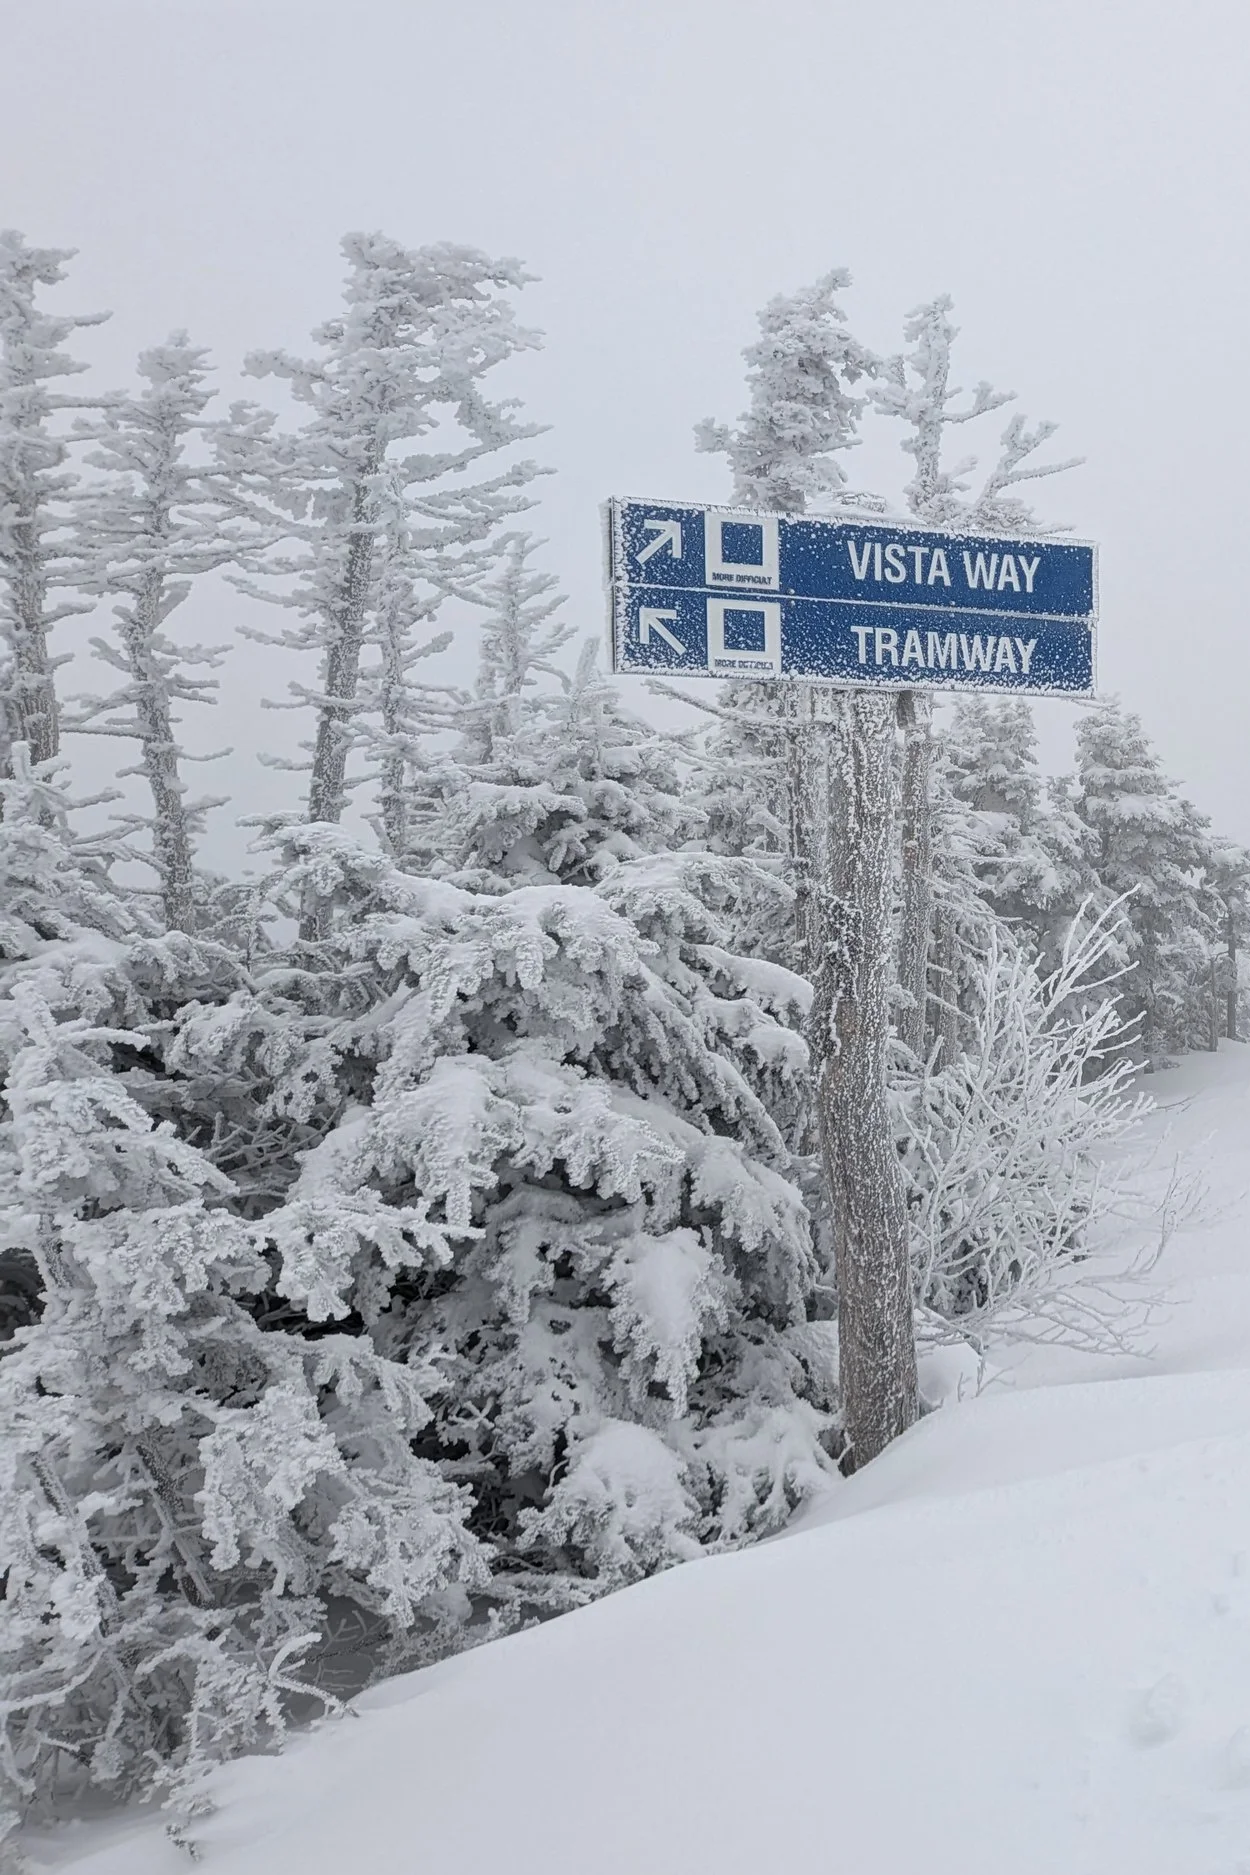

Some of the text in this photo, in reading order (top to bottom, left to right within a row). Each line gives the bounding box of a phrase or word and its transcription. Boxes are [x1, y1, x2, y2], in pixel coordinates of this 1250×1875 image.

[712, 572, 772, 585] MORE DIFFICULT
[847, 541, 1041, 593] VISTA WAY
[850, 625, 1039, 675] TRAMWAY
